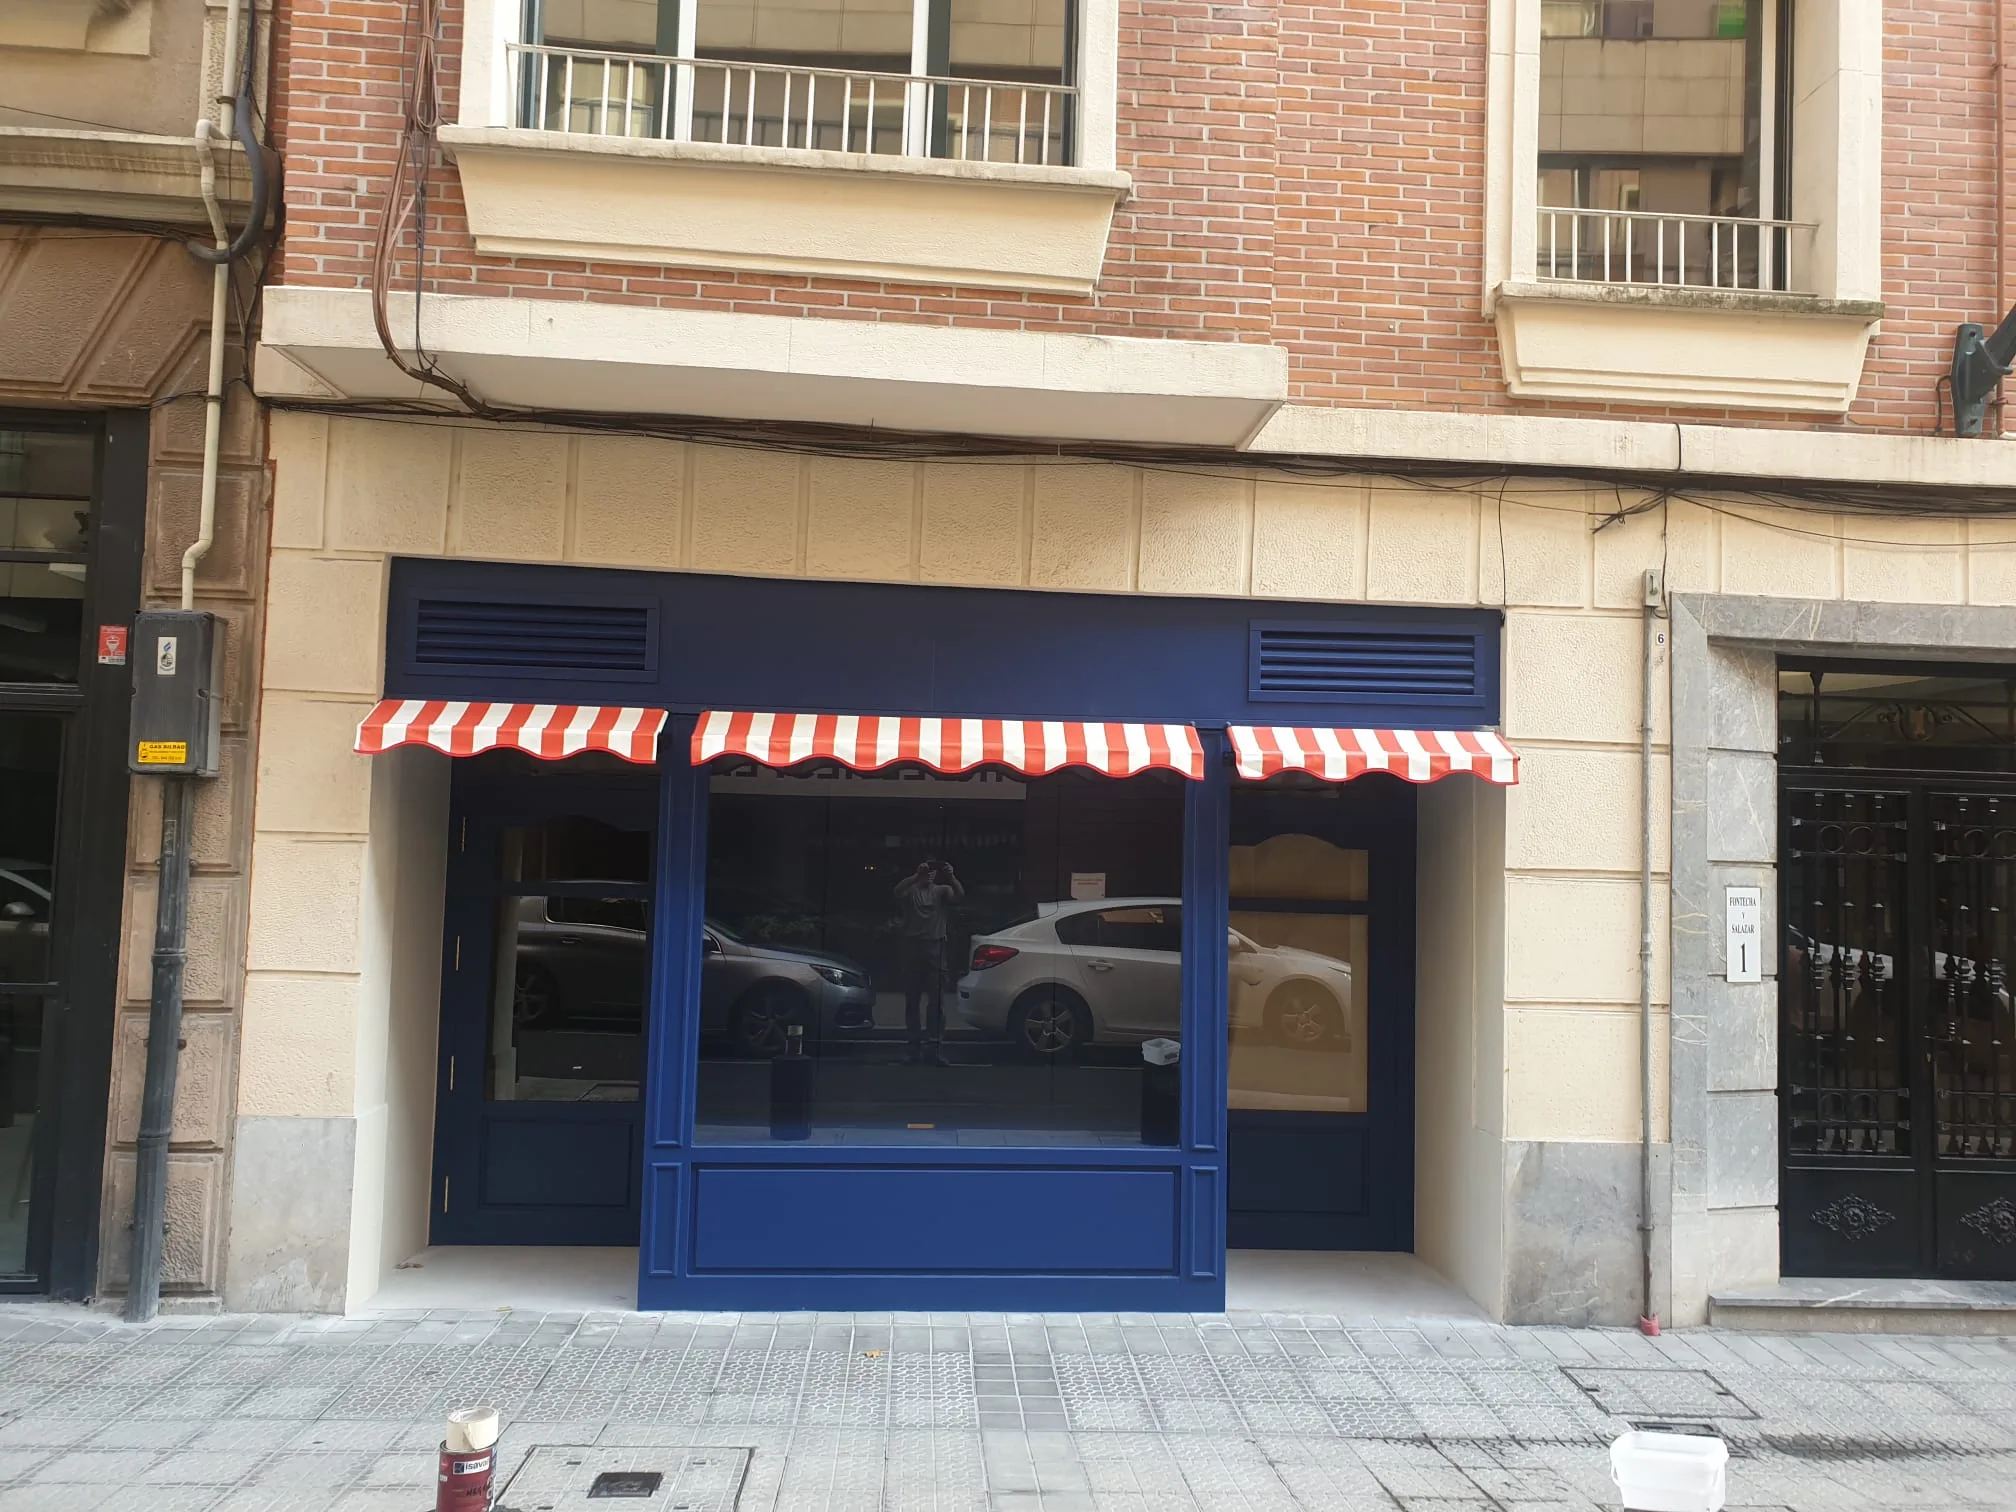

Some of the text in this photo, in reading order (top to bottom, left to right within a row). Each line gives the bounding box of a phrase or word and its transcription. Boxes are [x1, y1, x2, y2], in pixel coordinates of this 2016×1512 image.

[1657, 633, 1665, 644] 6
[1729, 896, 1757, 907] FONTECHA
[1741, 911, 1746, 920] Y
[1731, 923, 1755, 934] SALAZAR
[1740, 944, 1747, 973] 1
